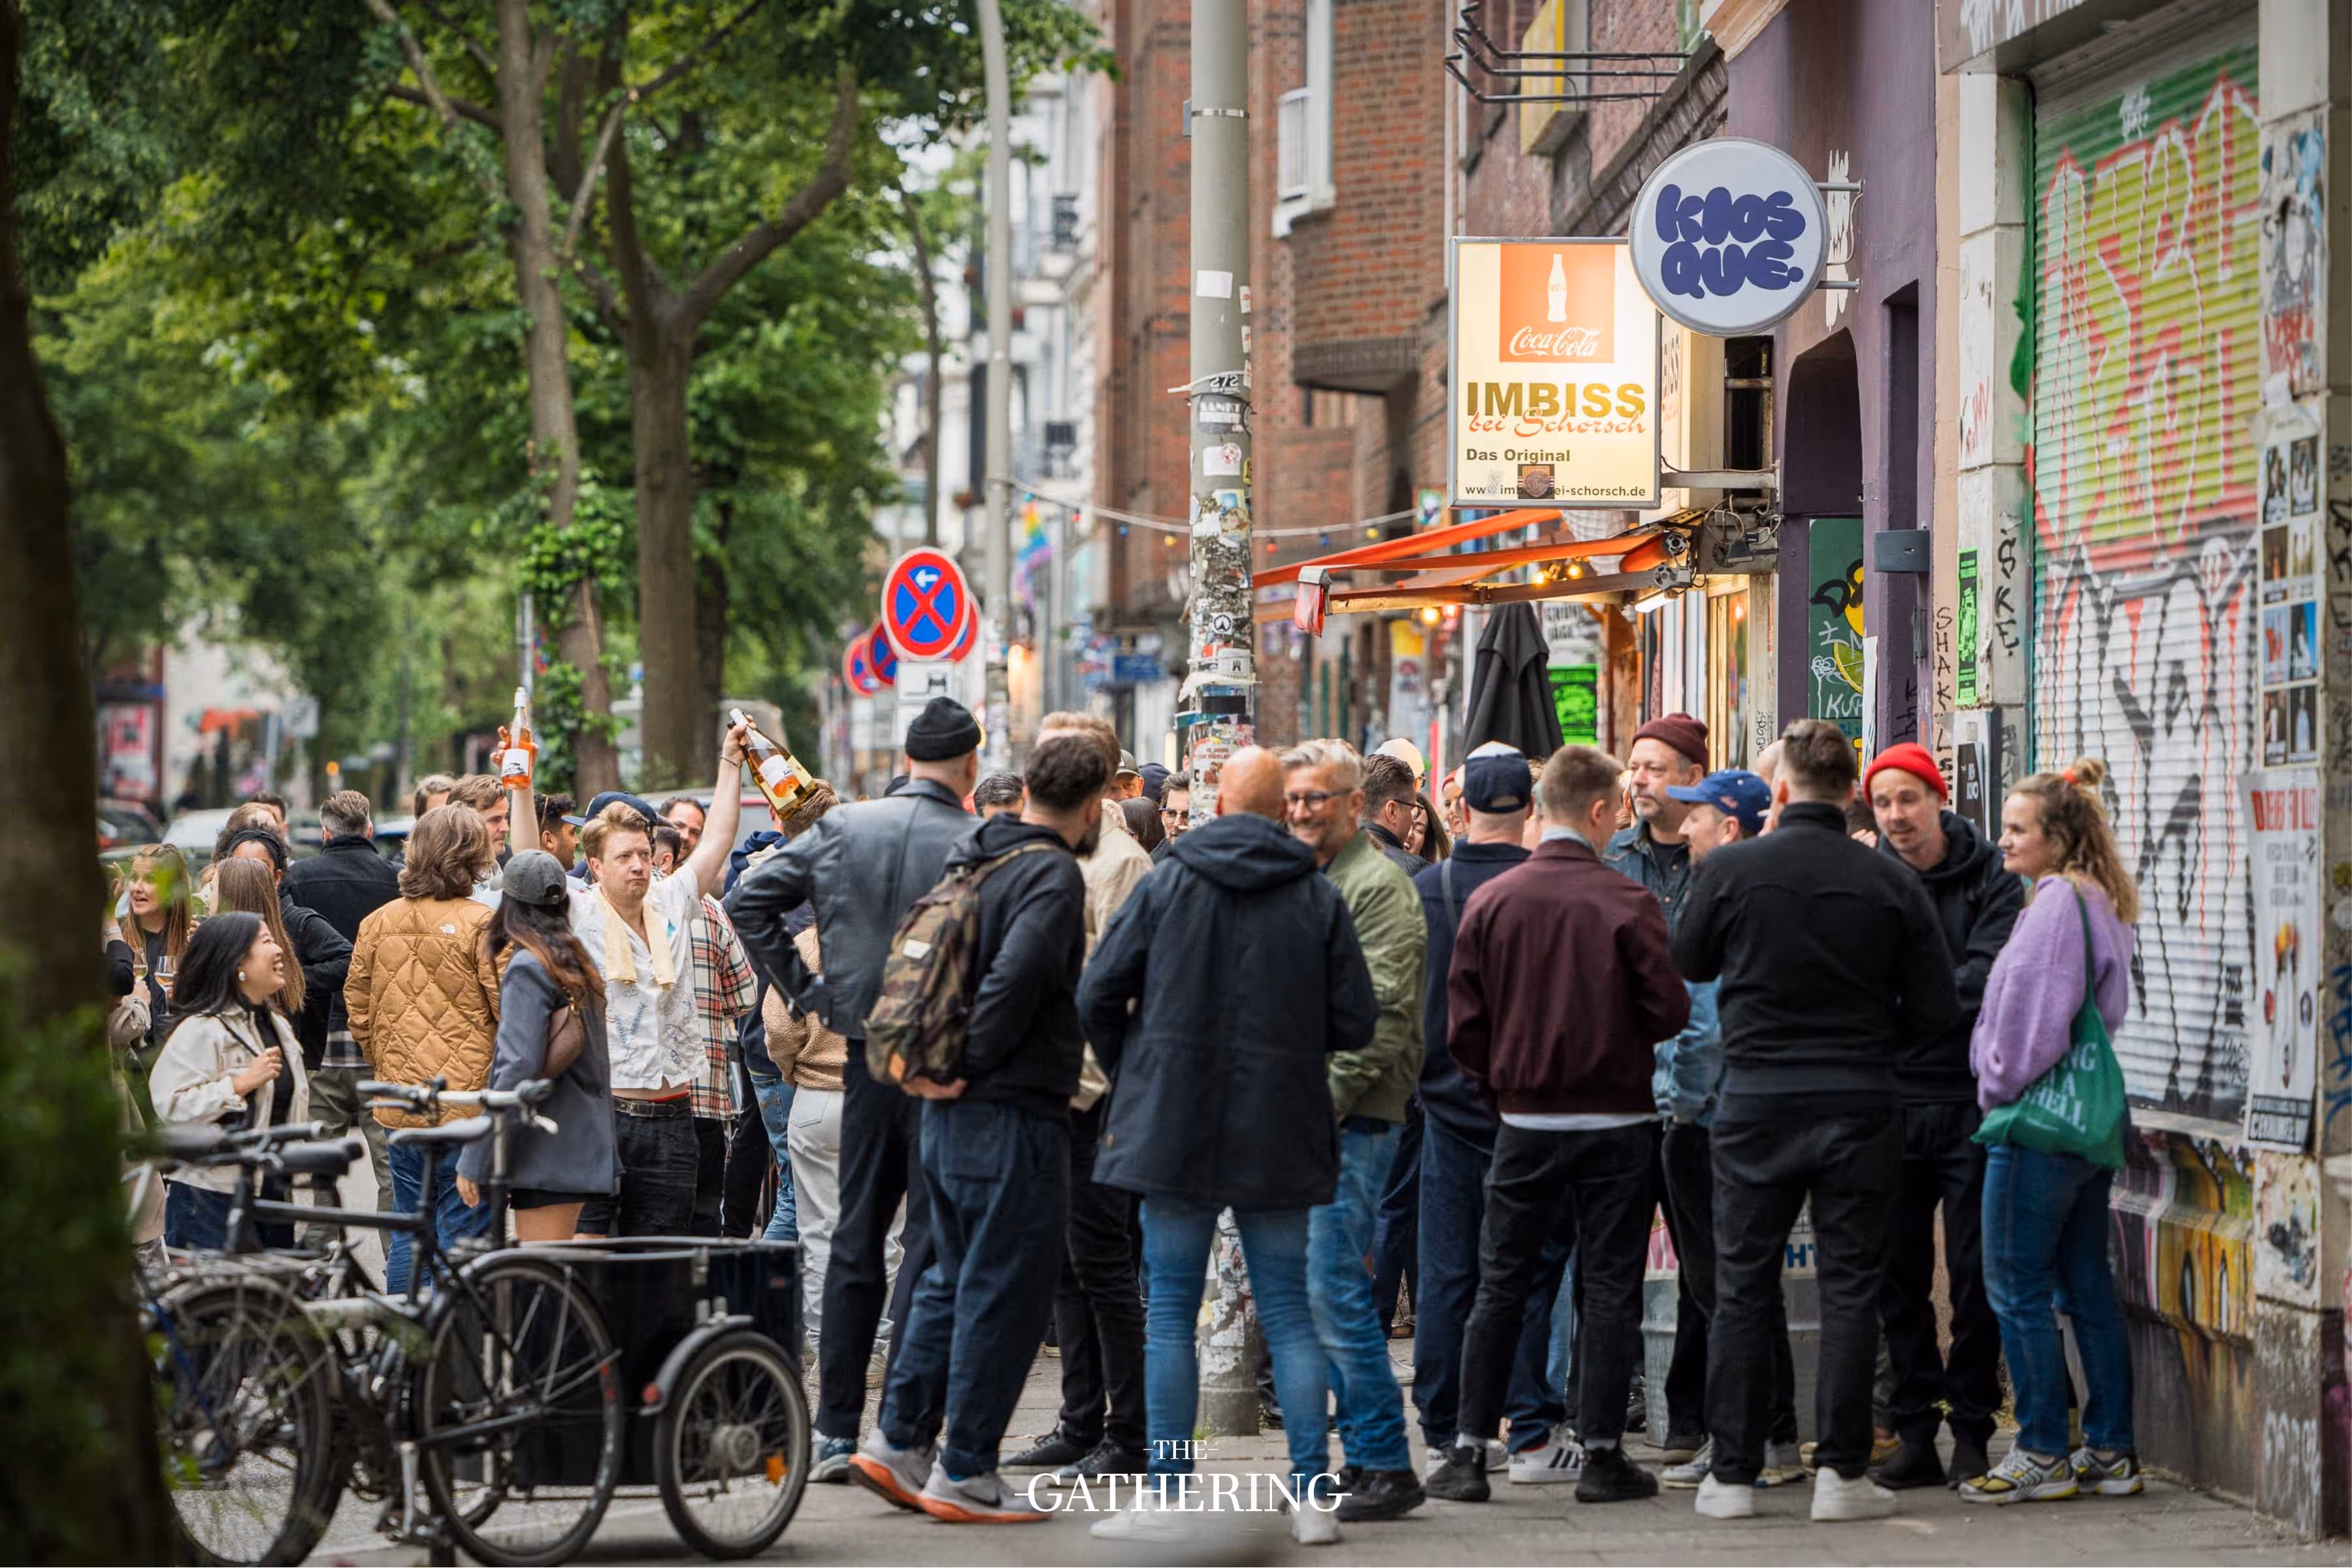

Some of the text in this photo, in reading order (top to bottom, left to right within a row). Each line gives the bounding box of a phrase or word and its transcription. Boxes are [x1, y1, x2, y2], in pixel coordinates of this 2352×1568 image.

[1656, 184, 1806, 245] KIOS
[1467, 382, 1646, 418] IMBISS
[1468, 410, 1506, 434] bei
[1514, 406, 1647, 437] Schorsch
[1467, 448, 1571, 465] Das Original
